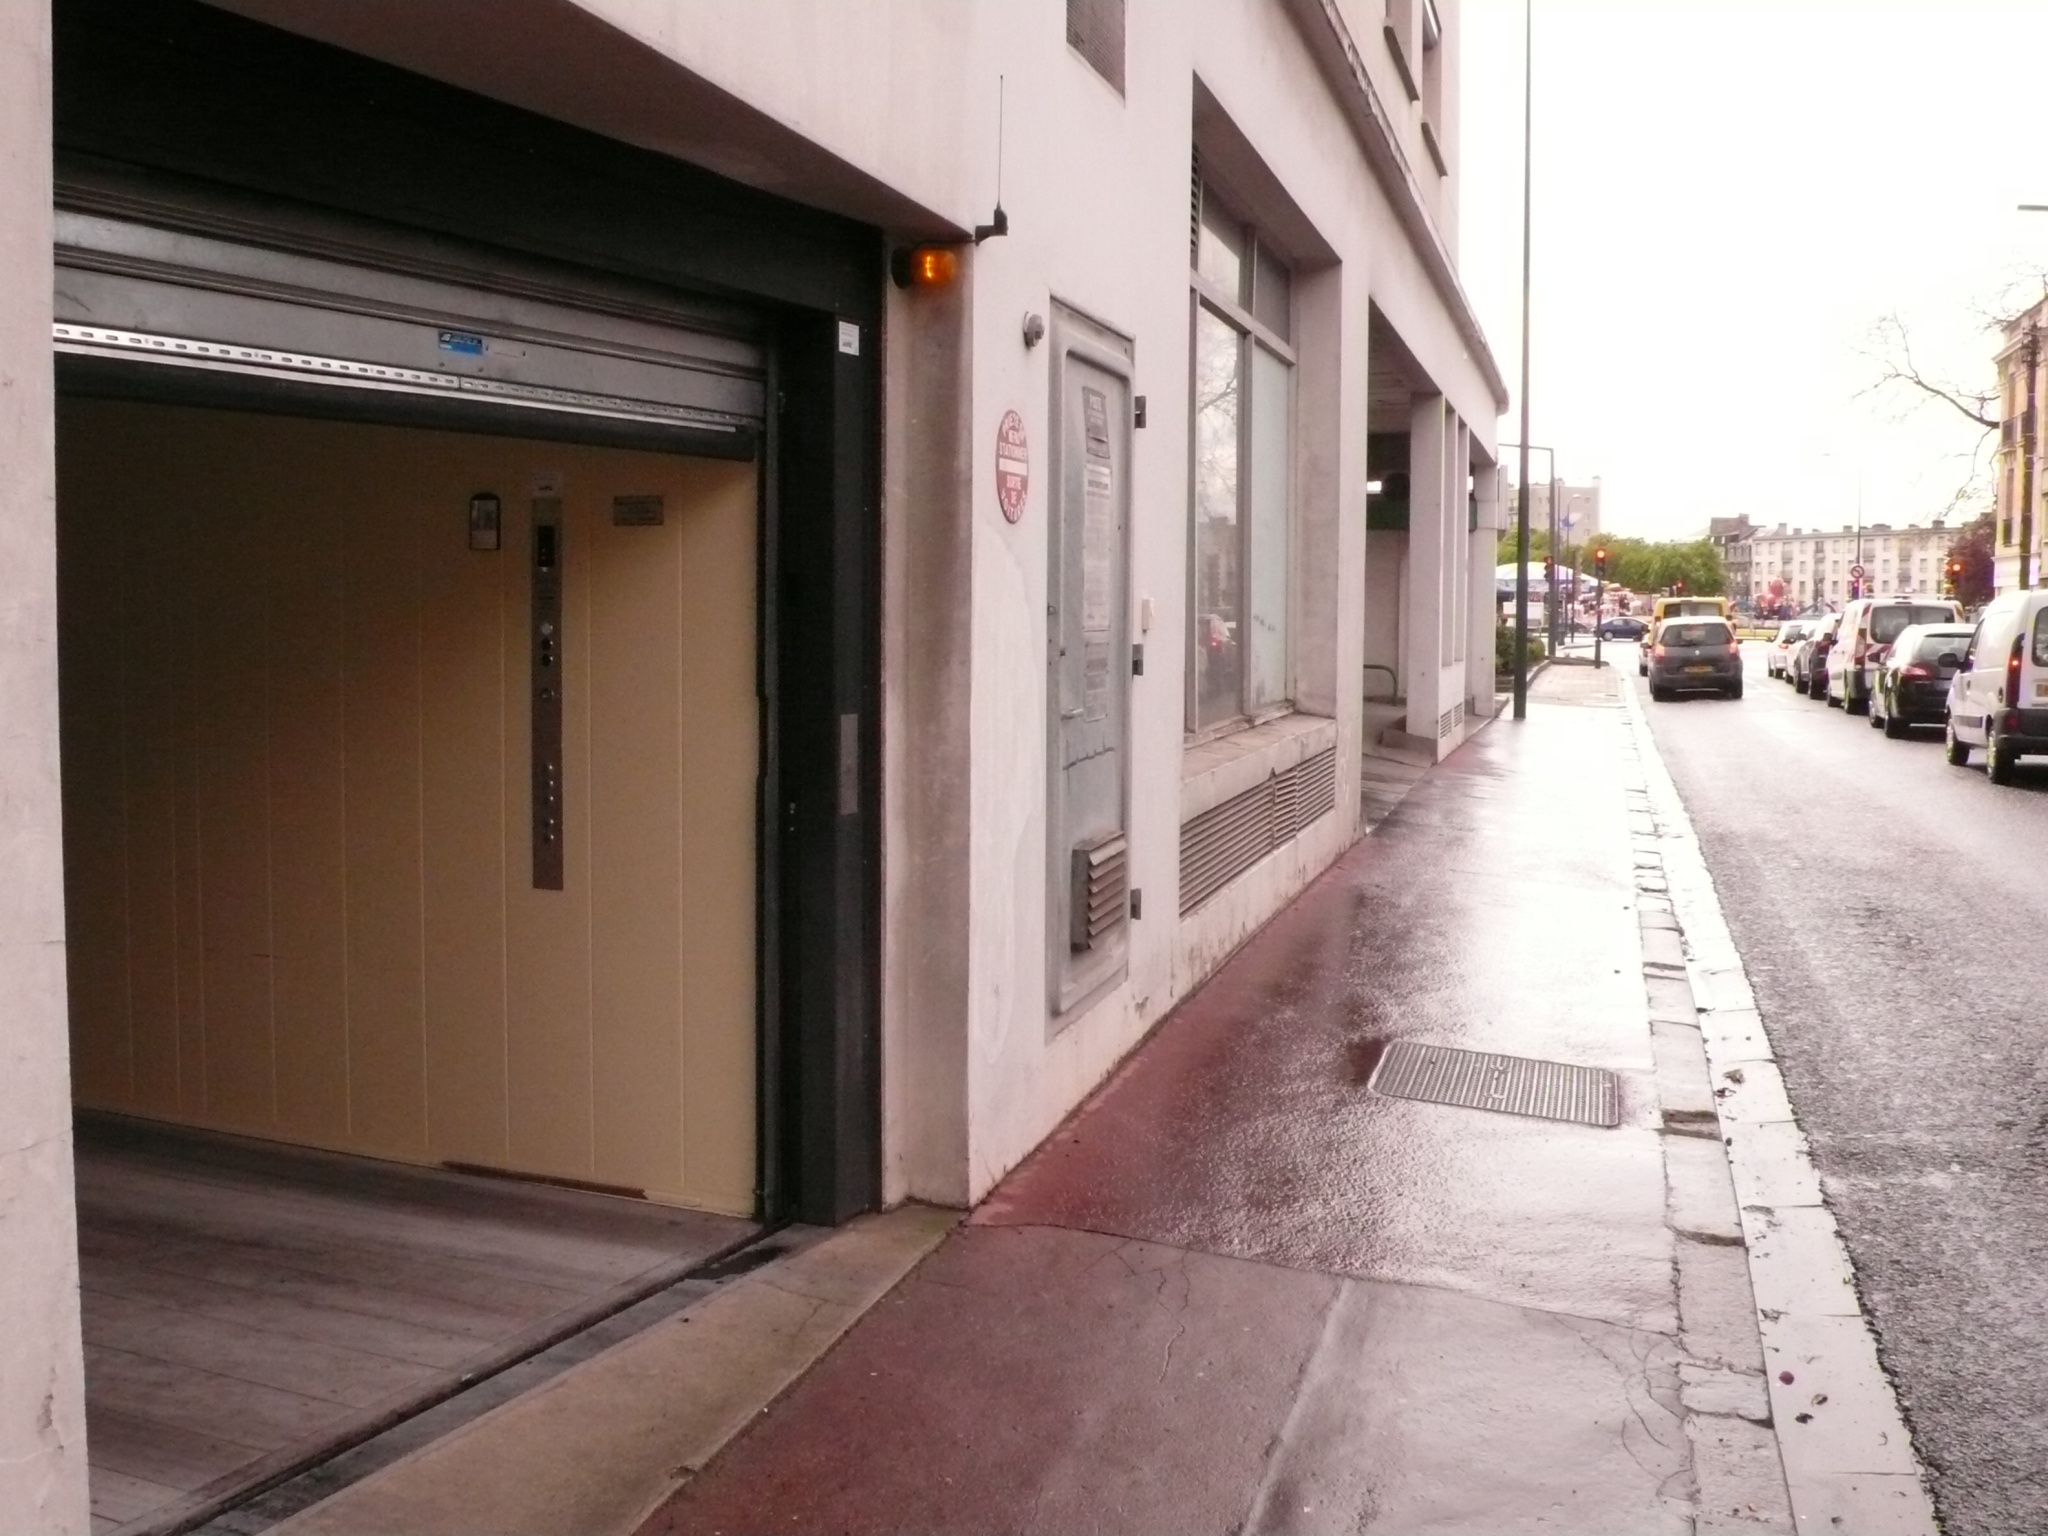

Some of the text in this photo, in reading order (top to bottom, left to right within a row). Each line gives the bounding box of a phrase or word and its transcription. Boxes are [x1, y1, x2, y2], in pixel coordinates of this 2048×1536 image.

[999, 441, 1027, 461] STATIONNER
[1006, 474, 1021, 490] SORTIE
[1010, 490, 1017, 504] DE
